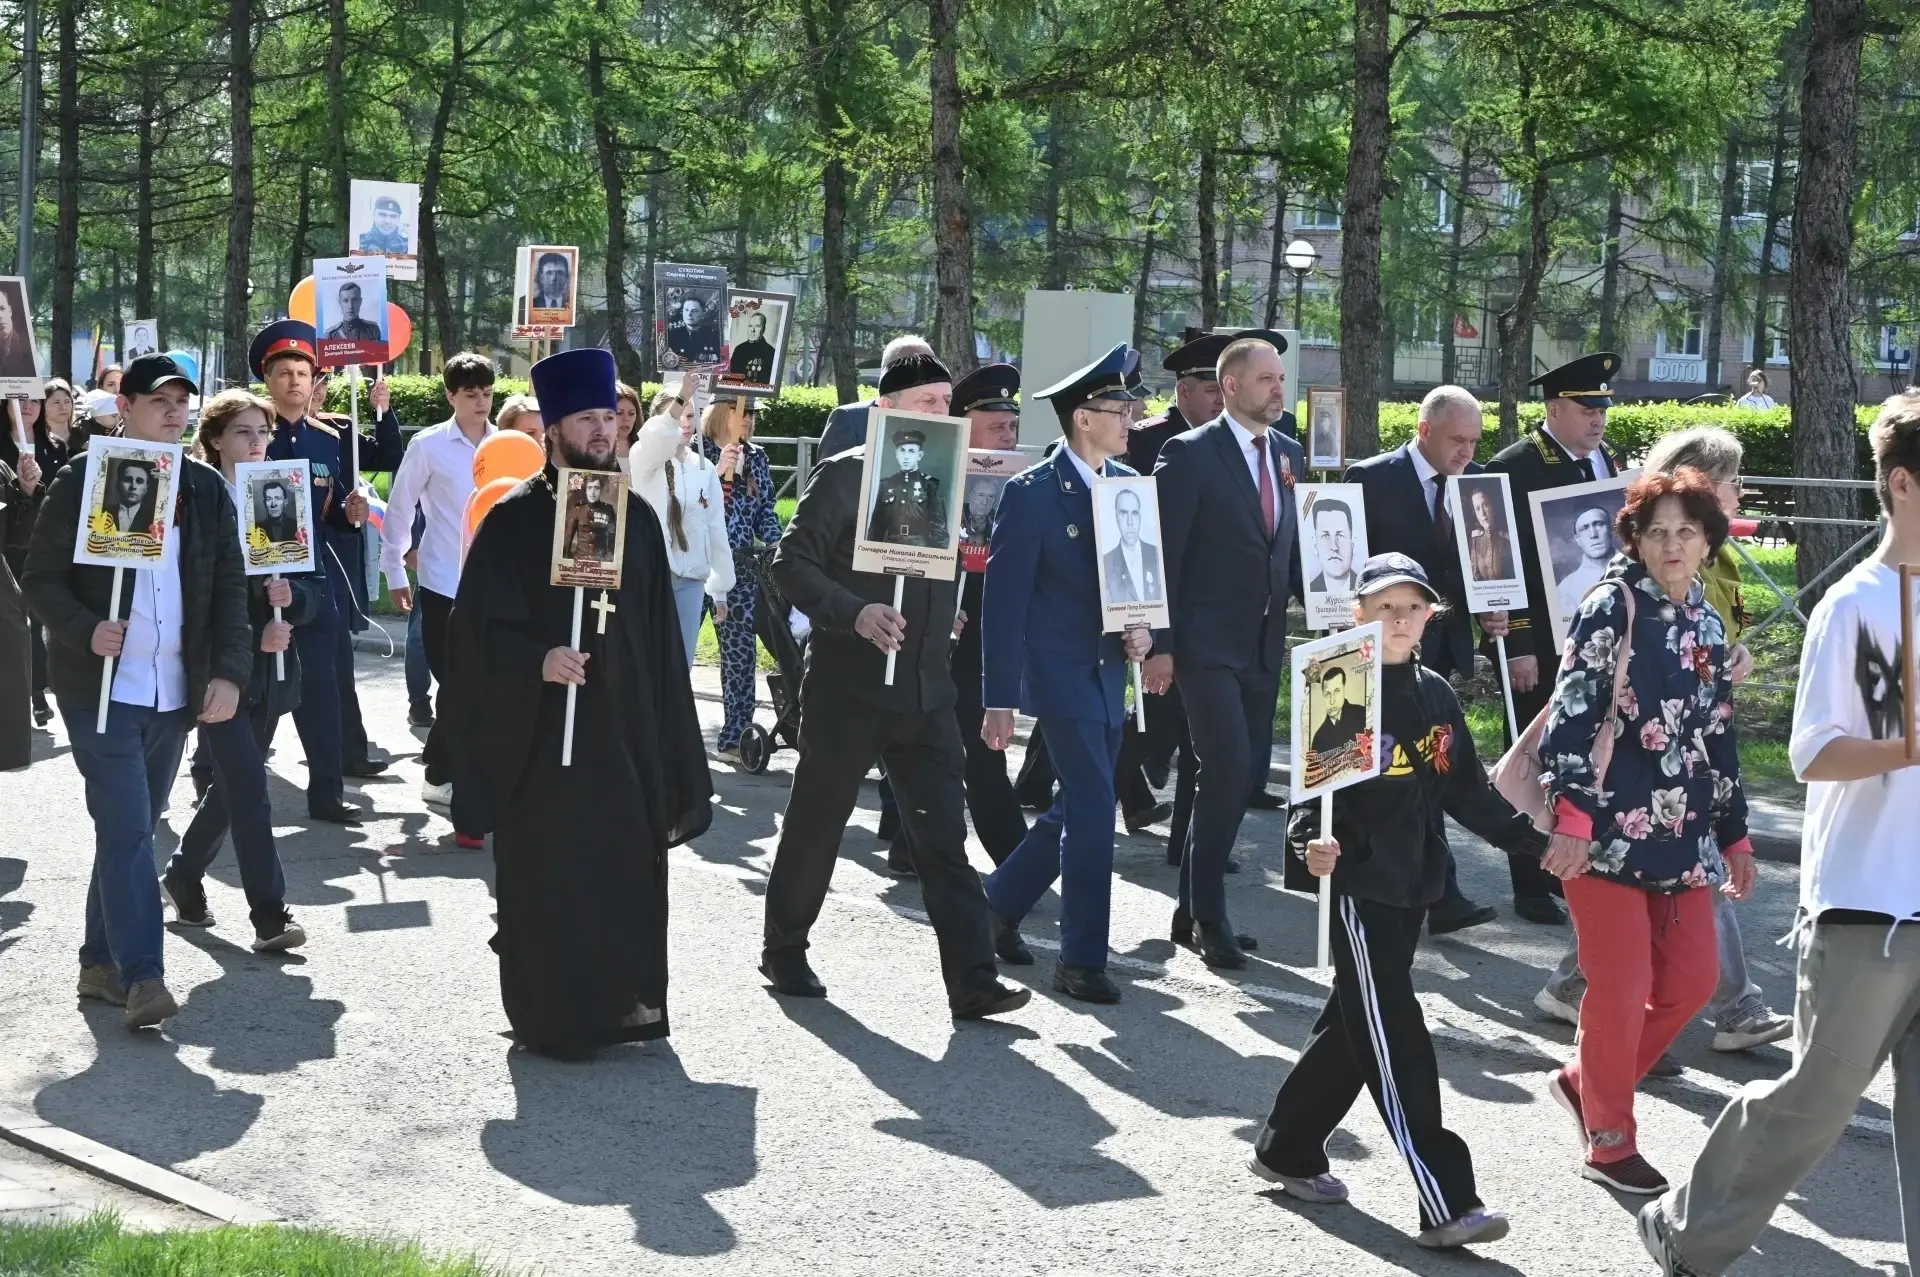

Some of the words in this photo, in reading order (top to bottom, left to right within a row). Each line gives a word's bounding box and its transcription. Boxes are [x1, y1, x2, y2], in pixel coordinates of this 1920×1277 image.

[323, 342, 356, 351] АЛЕКСЕЕВ
[1654, 361, 1699, 382] ФОТО
[90, 533, 130, 543] Мокрицкий
[131, 537, 156, 545] Максим
[857, 545, 888, 554] Гончаров
[889, 548, 916, 557] Николай
[917, 551, 955, 561] Васильевич
